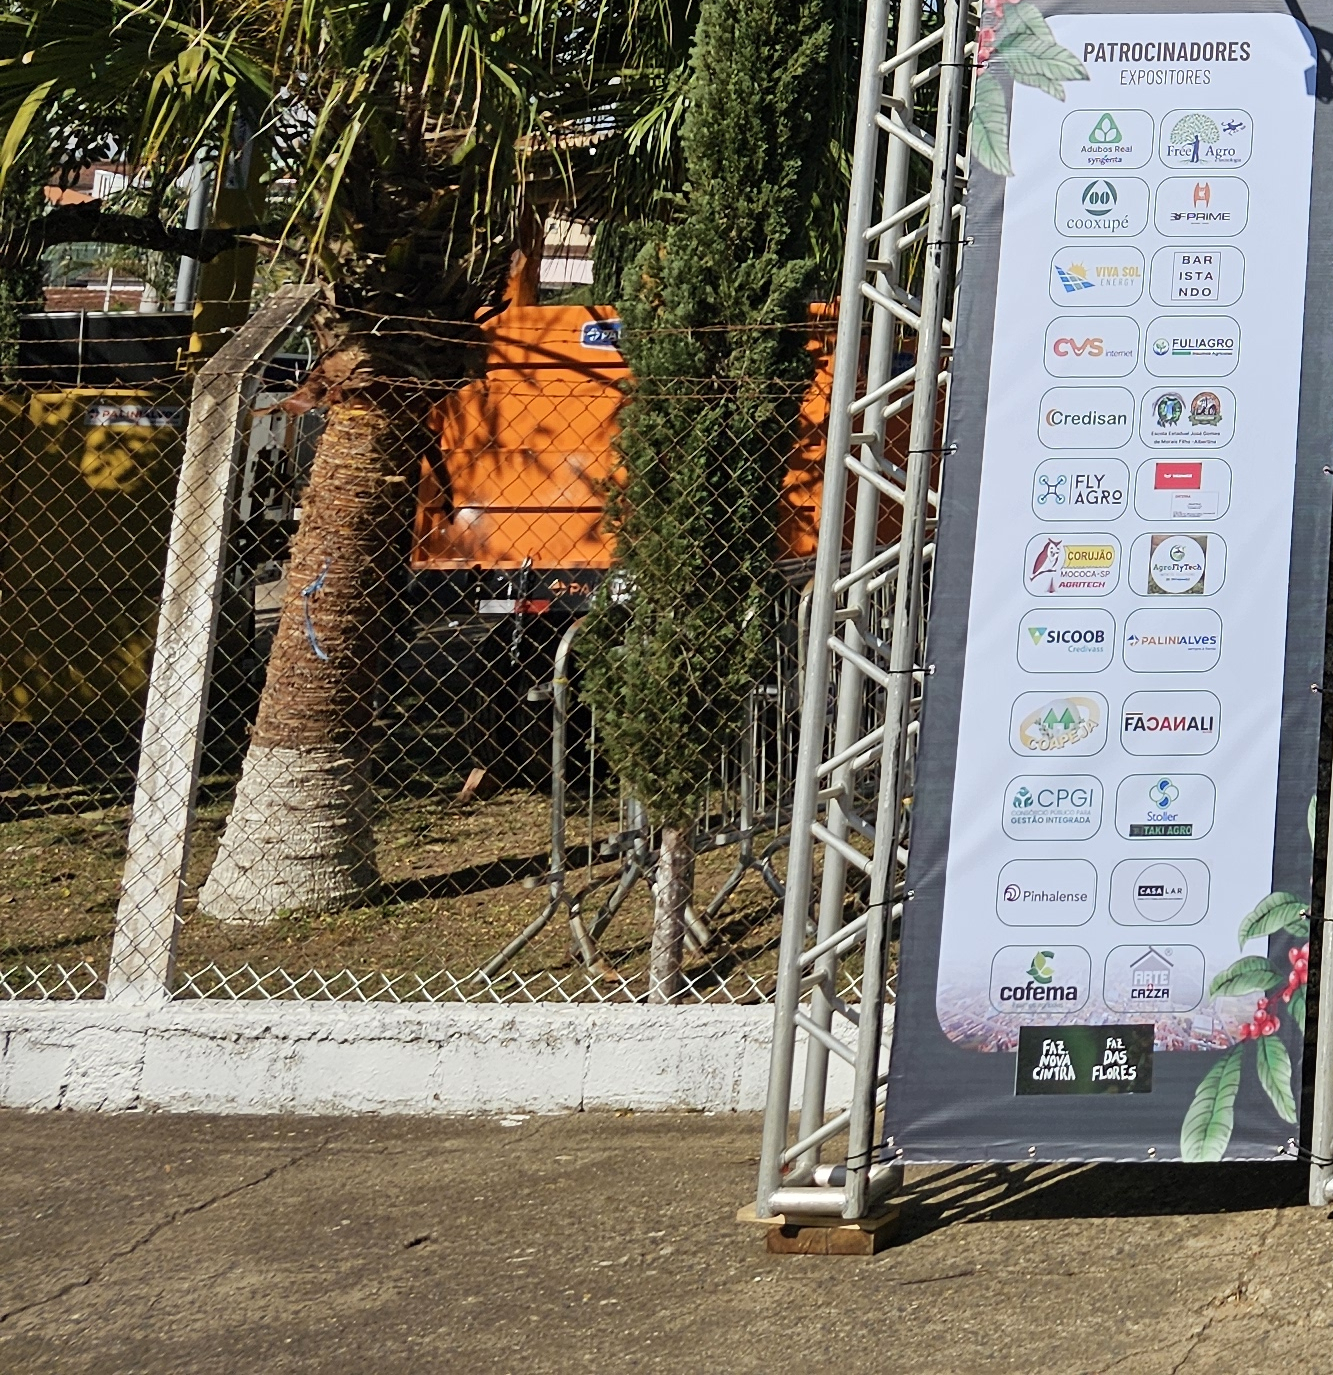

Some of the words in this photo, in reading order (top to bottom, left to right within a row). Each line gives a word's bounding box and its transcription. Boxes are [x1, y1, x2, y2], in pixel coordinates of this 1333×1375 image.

[1083, 41, 1251, 62] PATROCINADORES
[1120, 69, 1211, 85] EXPOSITORES
[1081, 145, 1113, 153] Adubos
[1114, 145, 1133, 153] Real
[1167, 145, 1192, 157] Free
[1205, 145, 1236, 161] Agro
[1087, 156, 1123, 166] syngenta
[1066, 215, 1129, 233] cooxupé
[1182, 255, 1213, 265] BAR
[1096, 266, 1120, 278] VIVA
[1122, 266, 1142, 278] SOL
[1179, 271, 1213, 281] ISTA
[1101, 278, 1136, 287] ENERGY
[1178, 287, 1212, 297] NDO
[1053, 337, 1104, 357] CVS
[1172, 338, 1234, 348] FULIAGRO
[1105, 349, 1133, 358] internet
[1051, 410, 1127, 425] Credisan
[1075, 474, 1105, 489] FLY
[1074, 490, 1123, 505] AGRO
[1067, 548, 1113, 561] CORUJÃO
[1153, 564, 1202, 572] AgroFlyTech
[1047, 630, 1105, 643] SICOOB
[1068, 645, 1104, 653] Credivass
[1027, 718, 1100, 752] COAPEJA
[1037, 788, 1094, 808] CPGI
[1011, 815, 1044, 824] GESTÃO
[1147, 811, 1178, 822] Stoller
[1144, 825, 1165, 835] TAKI
[1167, 825, 1192, 835] AGRO
[1023, 890, 1087, 902] Pinhalense
[1139, 887, 1163, 895] CASA
[1134, 970, 1169, 985] ARTE
[1000, 980, 1078, 1001] cofema
[1131, 987, 1170, 999] CAZZA
[1106, 1037, 1126, 1049] FAZ
[1039, 1054, 1071, 1066] NOVA
[1104, 1050, 1128, 1065] DAS
[1092, 1065, 1137, 1081] FLORES
